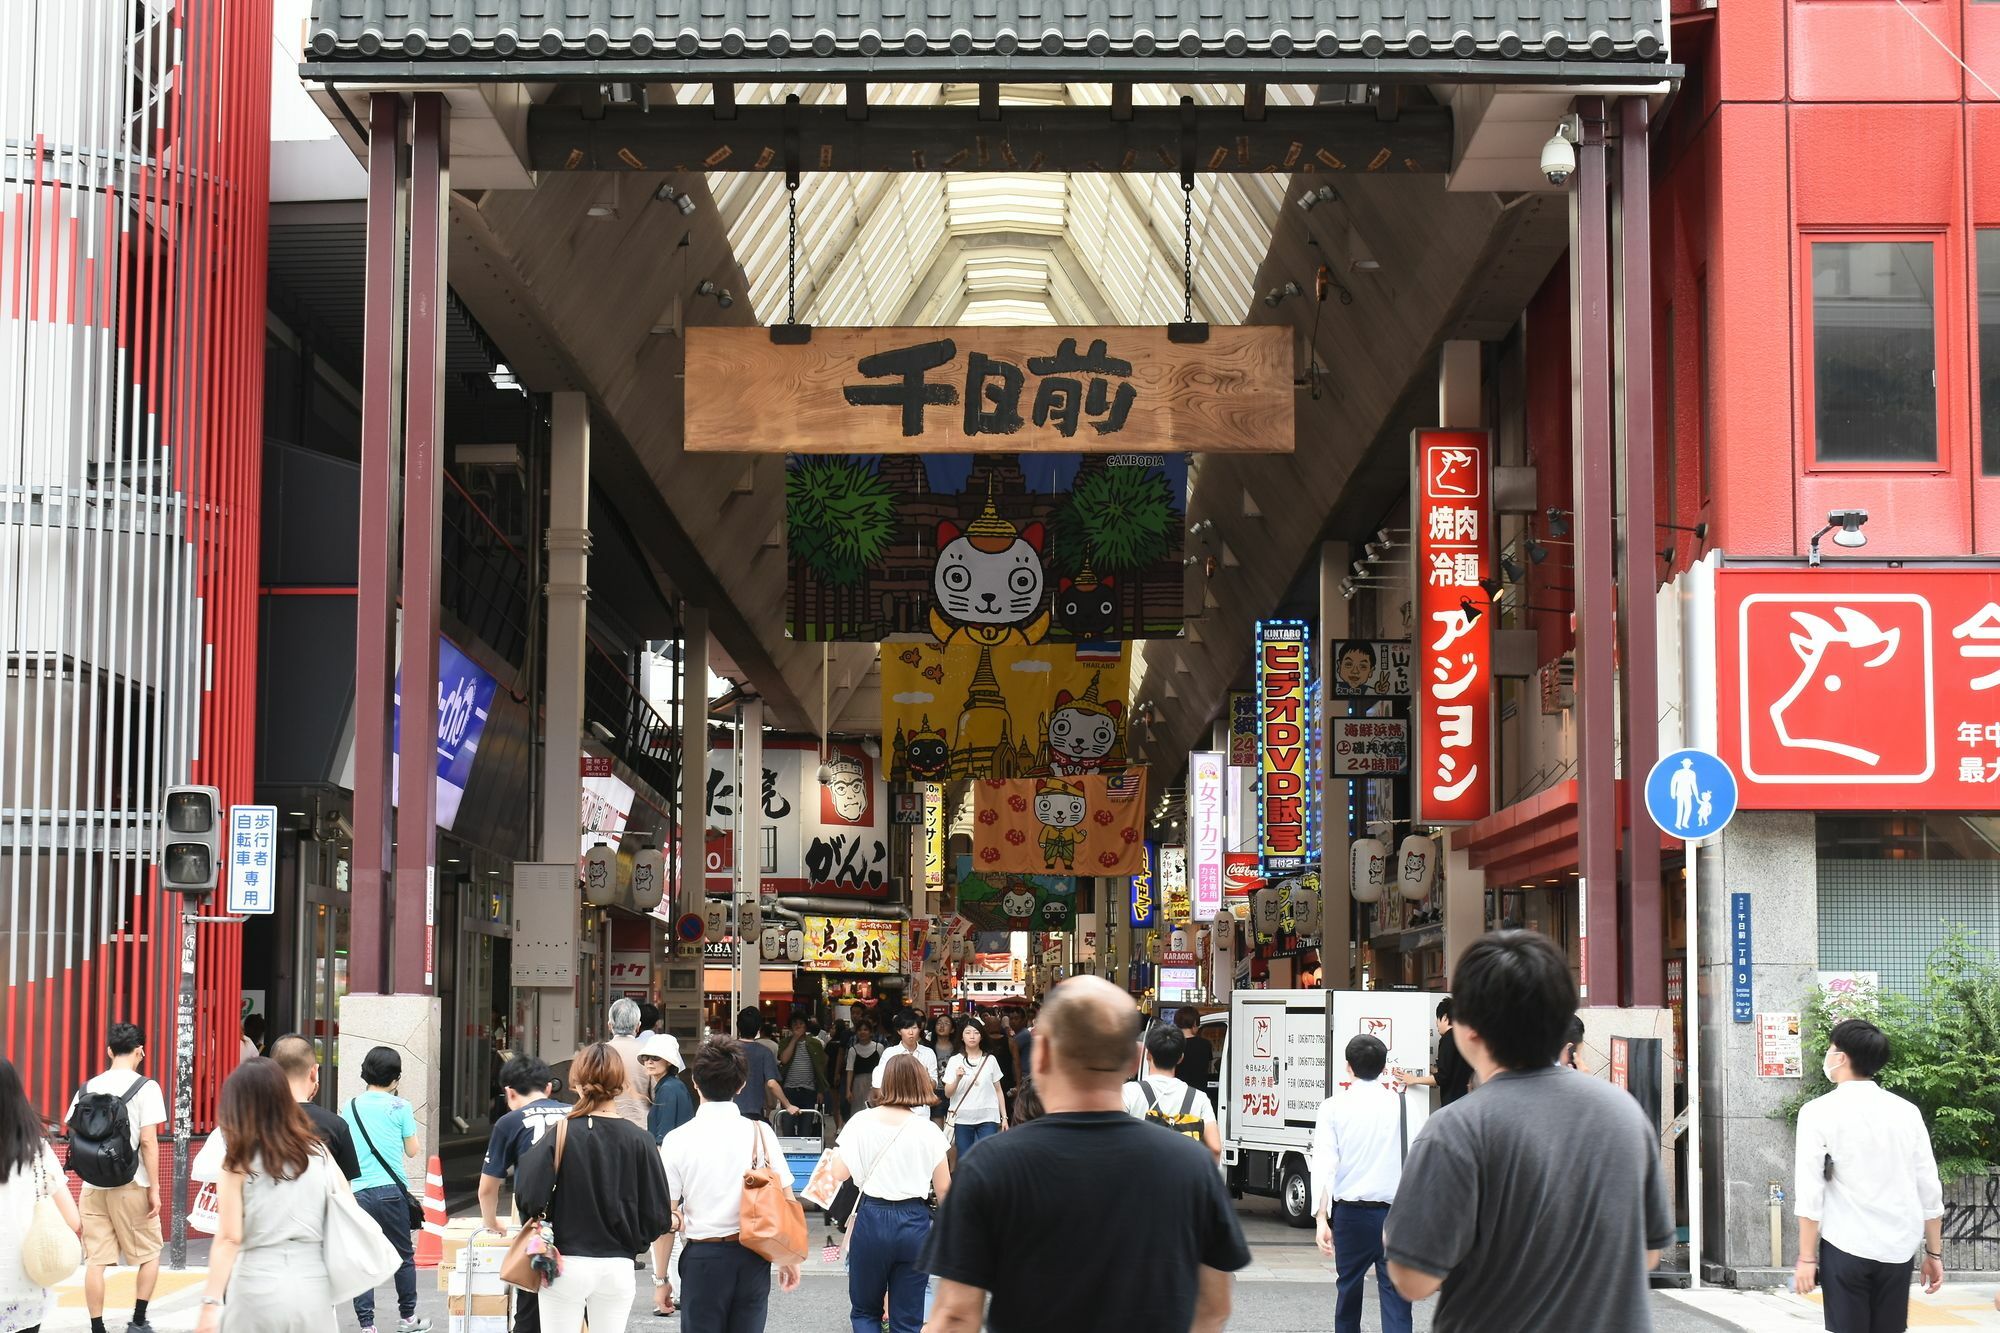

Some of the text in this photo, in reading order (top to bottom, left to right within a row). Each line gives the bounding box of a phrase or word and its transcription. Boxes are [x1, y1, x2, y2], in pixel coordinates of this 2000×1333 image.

[843, 338, 1137, 437] 千日前
[1107, 455, 1165, 466] CAMBODIA
[1428, 506, 1479, 541] 焼肉
[1428, 552, 1480, 587] 冷麺
[1264, 629, 1301, 637] KINTARO
[1431, 610, 1479, 802] アジヨシ
[1344, 723, 1403, 737] 海鮮浜焼
[1265, 645, 1303, 853] ビデオDVD試写
[1347, 758, 1401, 771] 24時間
[926, 806, 937, 867] マッサージ
[1198, 782, 1219, 862] 女子カラ
[236, 814, 251, 866] 自転車
[254, 814, 270, 866] 歩行者
[805, 833, 887, 891] がんこ
[244, 870, 259, 906] 専用
[1200, 866, 1208, 899] カラオケ
[1209, 866, 1218, 899] 女性専用
[1164, 952, 1193, 960] KARAOKE
[1738, 913, 1746, 966] 千日前一丁目
[1739, 974, 1746, 984] 9
[1244, 1076, 1274, 1088] 焼肉・冷麺
[1245, 1064, 1272, 1072] 今日もよろしく
[1243, 1093, 1280, 1116] アジヨシ
